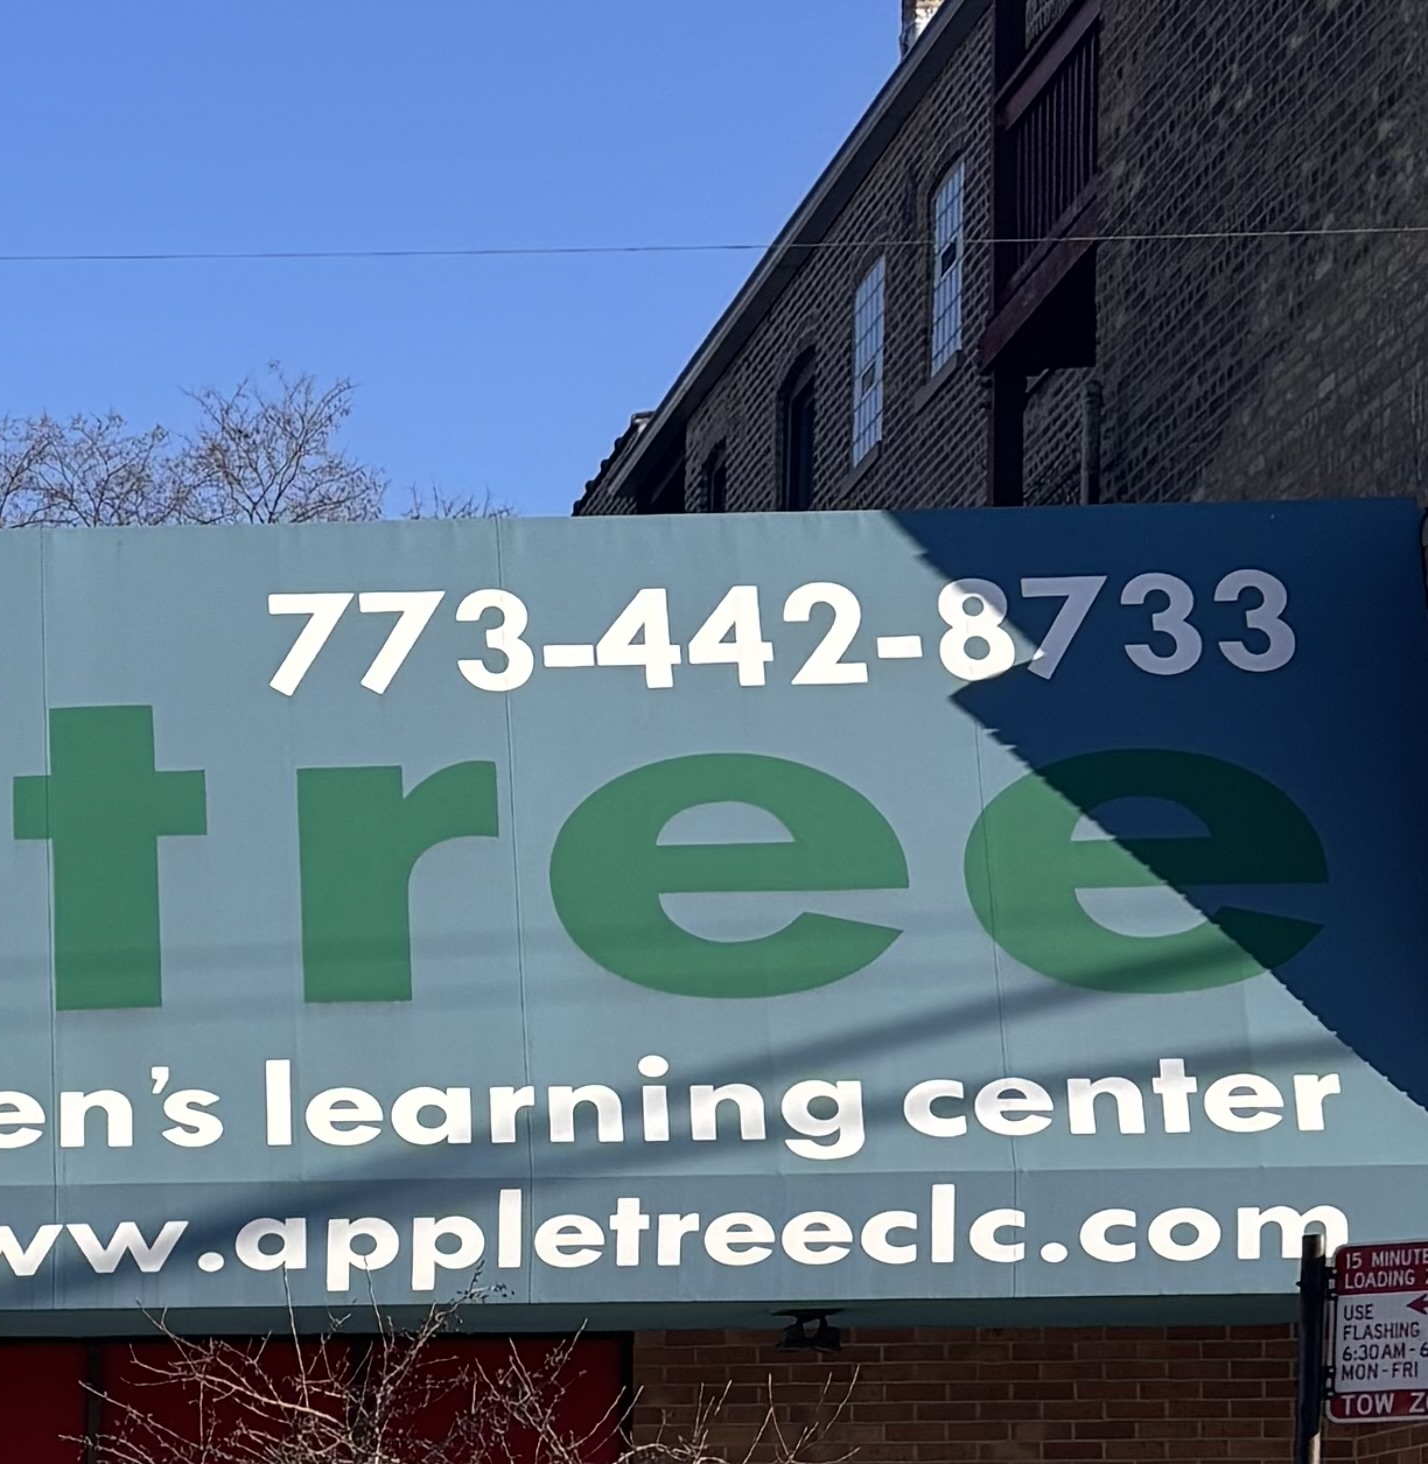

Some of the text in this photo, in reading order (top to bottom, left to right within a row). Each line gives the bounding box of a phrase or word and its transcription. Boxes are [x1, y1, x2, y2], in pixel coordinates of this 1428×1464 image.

[266, 569, 1297, 697] 773-442-8733
[12, 703, 1331, 1012] tree
[264, 1053, 867, 1162] learning
[902, 1056, 1343, 1140] center
[1345, 1252, 1363, 1270] 15
[1344, 1269, 1416, 1290] LOADING
[1344, 1303, 1374, 1321] USE
[1343, 1322, 1421, 1341] FLASHING
[1341, 1393, 1394, 1416] TOW
